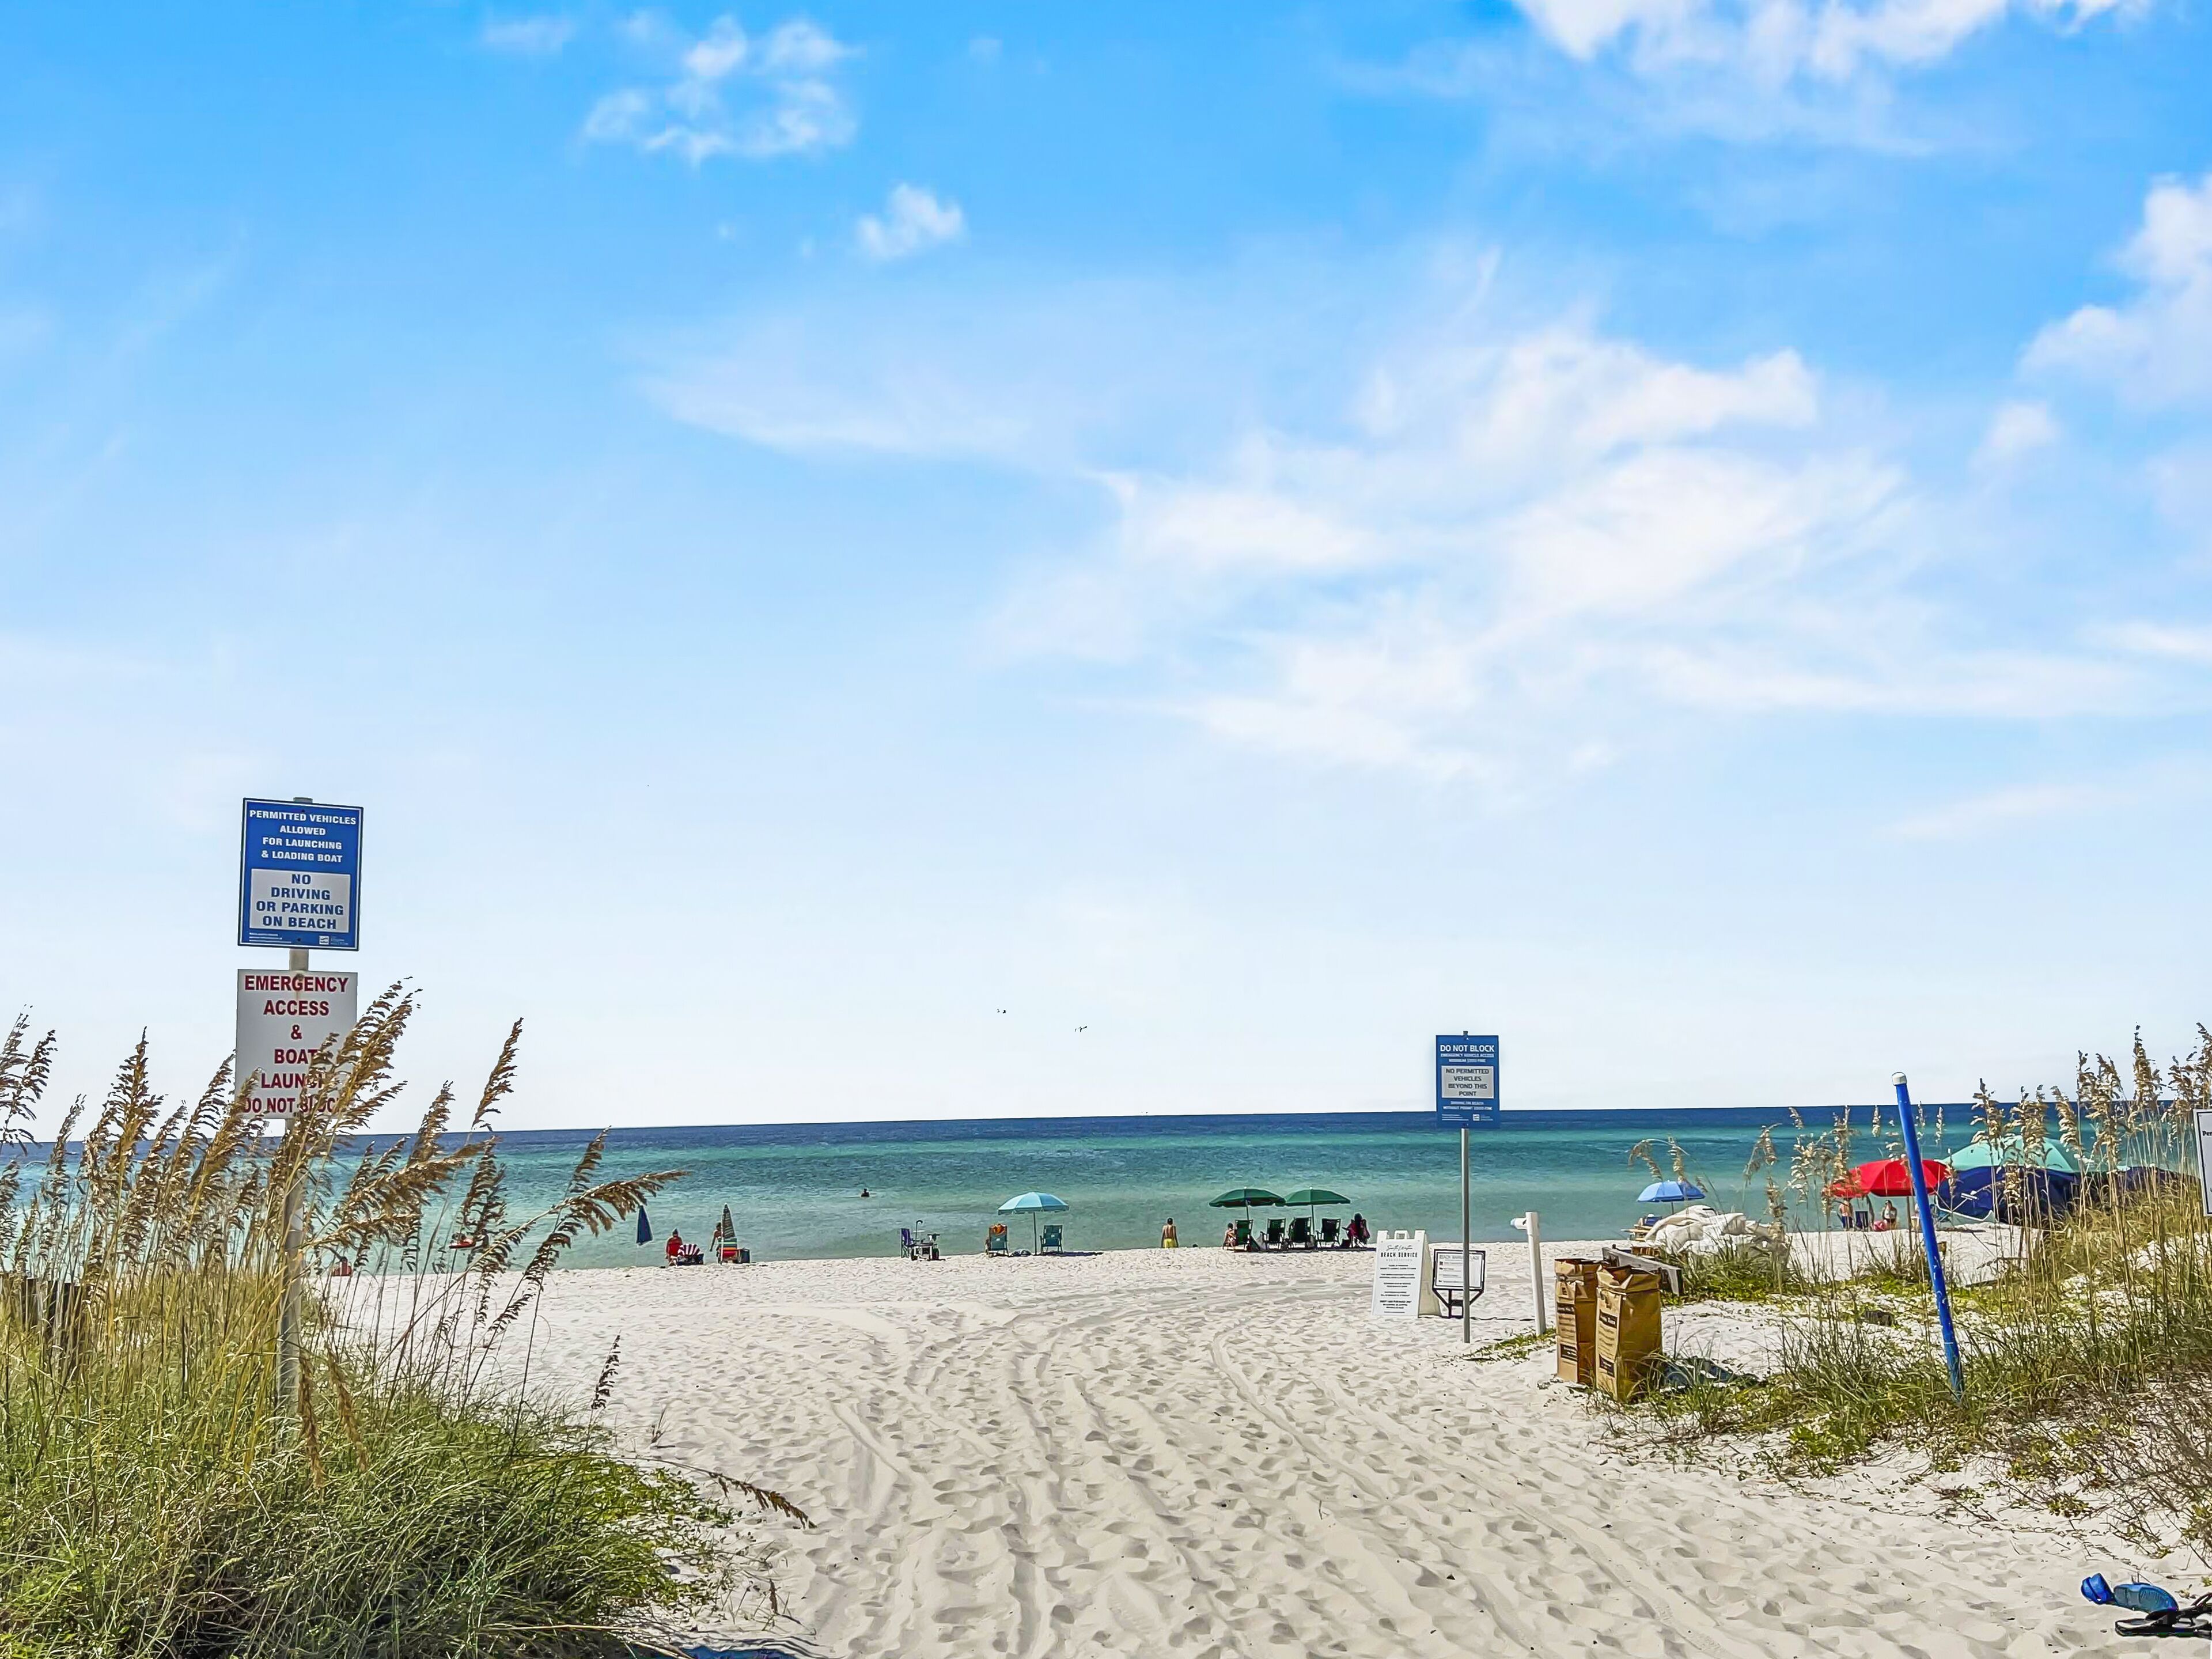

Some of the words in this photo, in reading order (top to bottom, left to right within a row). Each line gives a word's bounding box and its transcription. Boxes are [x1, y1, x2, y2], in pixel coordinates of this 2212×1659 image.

[249, 810, 306, 821] PERMITTED
[309, 814, 356, 824] VEHICLES
[279, 825, 326, 835] ALLOWED
[263, 837, 282, 846] FOR
[286, 839, 342, 850] LAUNCHING
[261, 850, 268, 858] &
[272, 851, 315, 861] LOADING
[317, 854, 343, 862] BOAT
[291, 874, 311, 885] NO
[271, 887, 330, 900] DRIVING
[256, 901, 276, 912] OR
[282, 902, 344, 915] PARKING
[263, 915, 282, 926] ON
[288, 917, 336, 930] BEACH
[245, 975, 349, 993] EMERGENCY
[263, 999, 329, 1016] ACCESS
[290, 1024, 302, 1040] &
[267, 1098, 296, 1113] NOT
